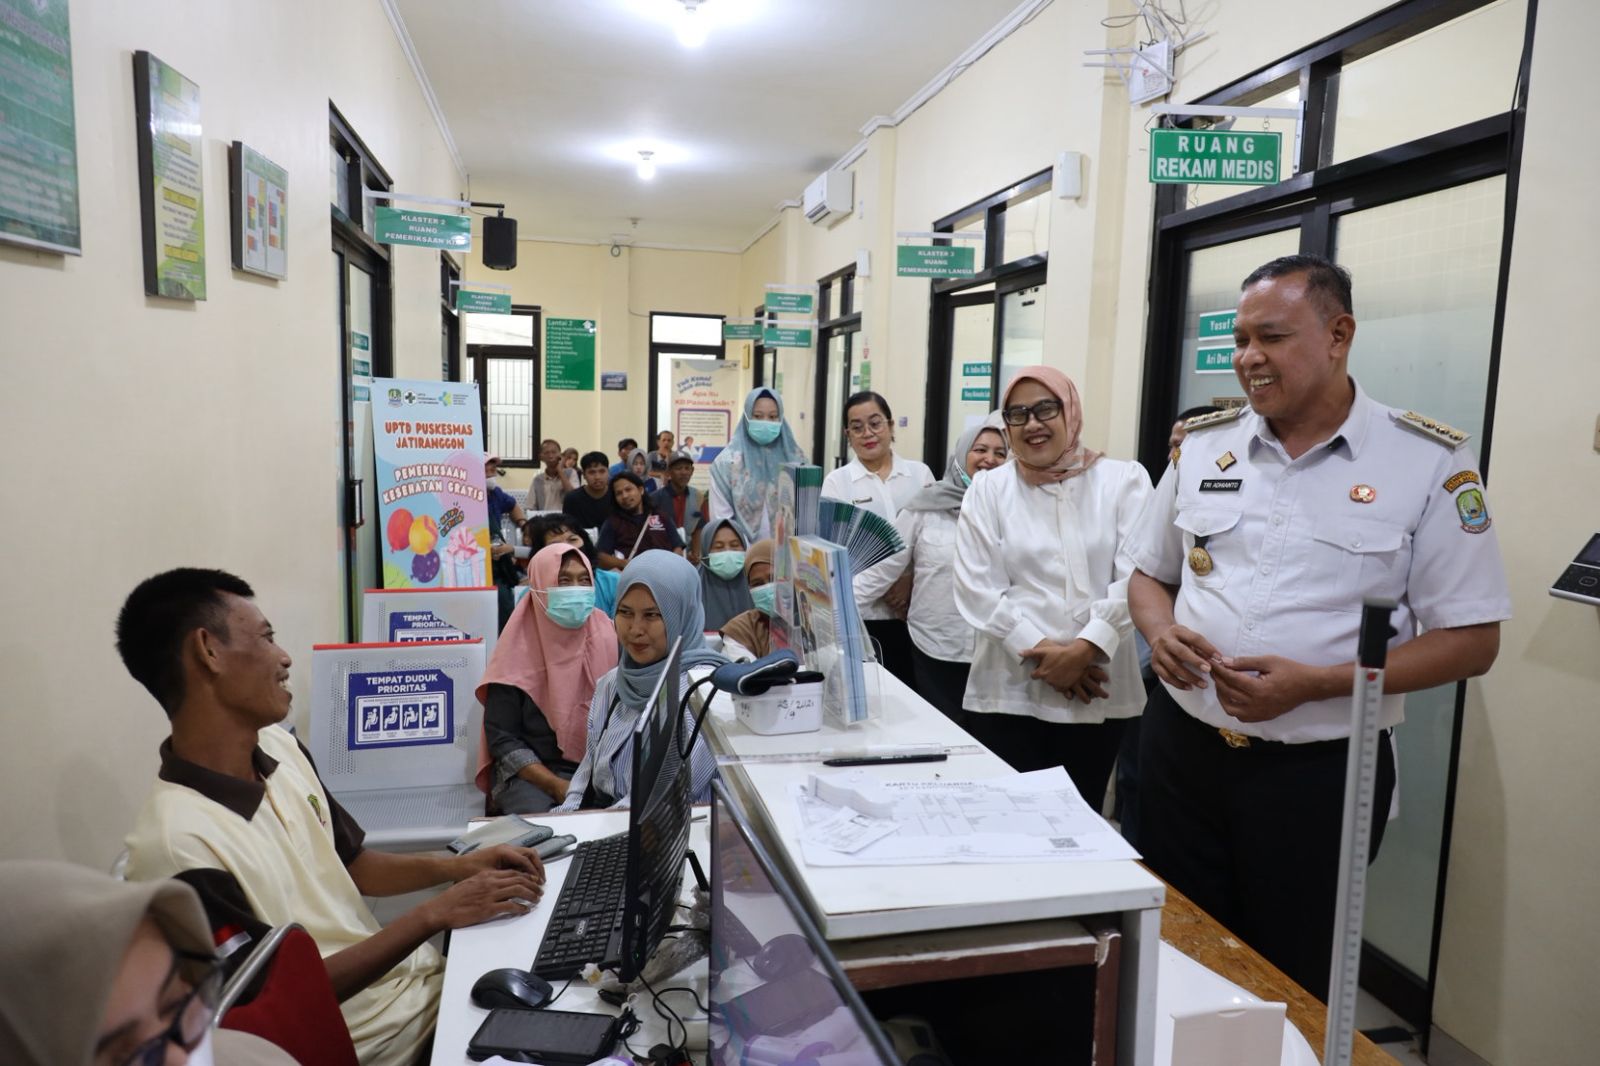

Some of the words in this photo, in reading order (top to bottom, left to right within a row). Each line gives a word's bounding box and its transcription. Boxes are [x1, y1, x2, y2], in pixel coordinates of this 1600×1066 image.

[1178, 135, 1255, 155] RUANG
[1156, 157, 1217, 178] REKAM
[1221, 159, 1275, 180] MEDIS
[401, 215, 439, 224] KLASTER
[408, 225, 438, 234] RUANG
[384, 232, 444, 245] PEMERIKSAAN
[1210, 318, 1231, 331] Yusuf
[1206, 353, 1216, 365] Ari
[385, 421, 412, 434] UPTD
[415, 422, 473, 435] PUSKESMAS
[394, 464, 467, 481] PEMERIKSAAN
[382, 480, 442, 504] KESEHATAN
[447, 481, 484, 501] GRATIS
[403, 614, 432, 622] TEMPAT
[366, 675, 403, 685] TEMPAT
[405, 673, 438, 683] DUDUK
[377, 683, 427, 694] PRIORITAS
